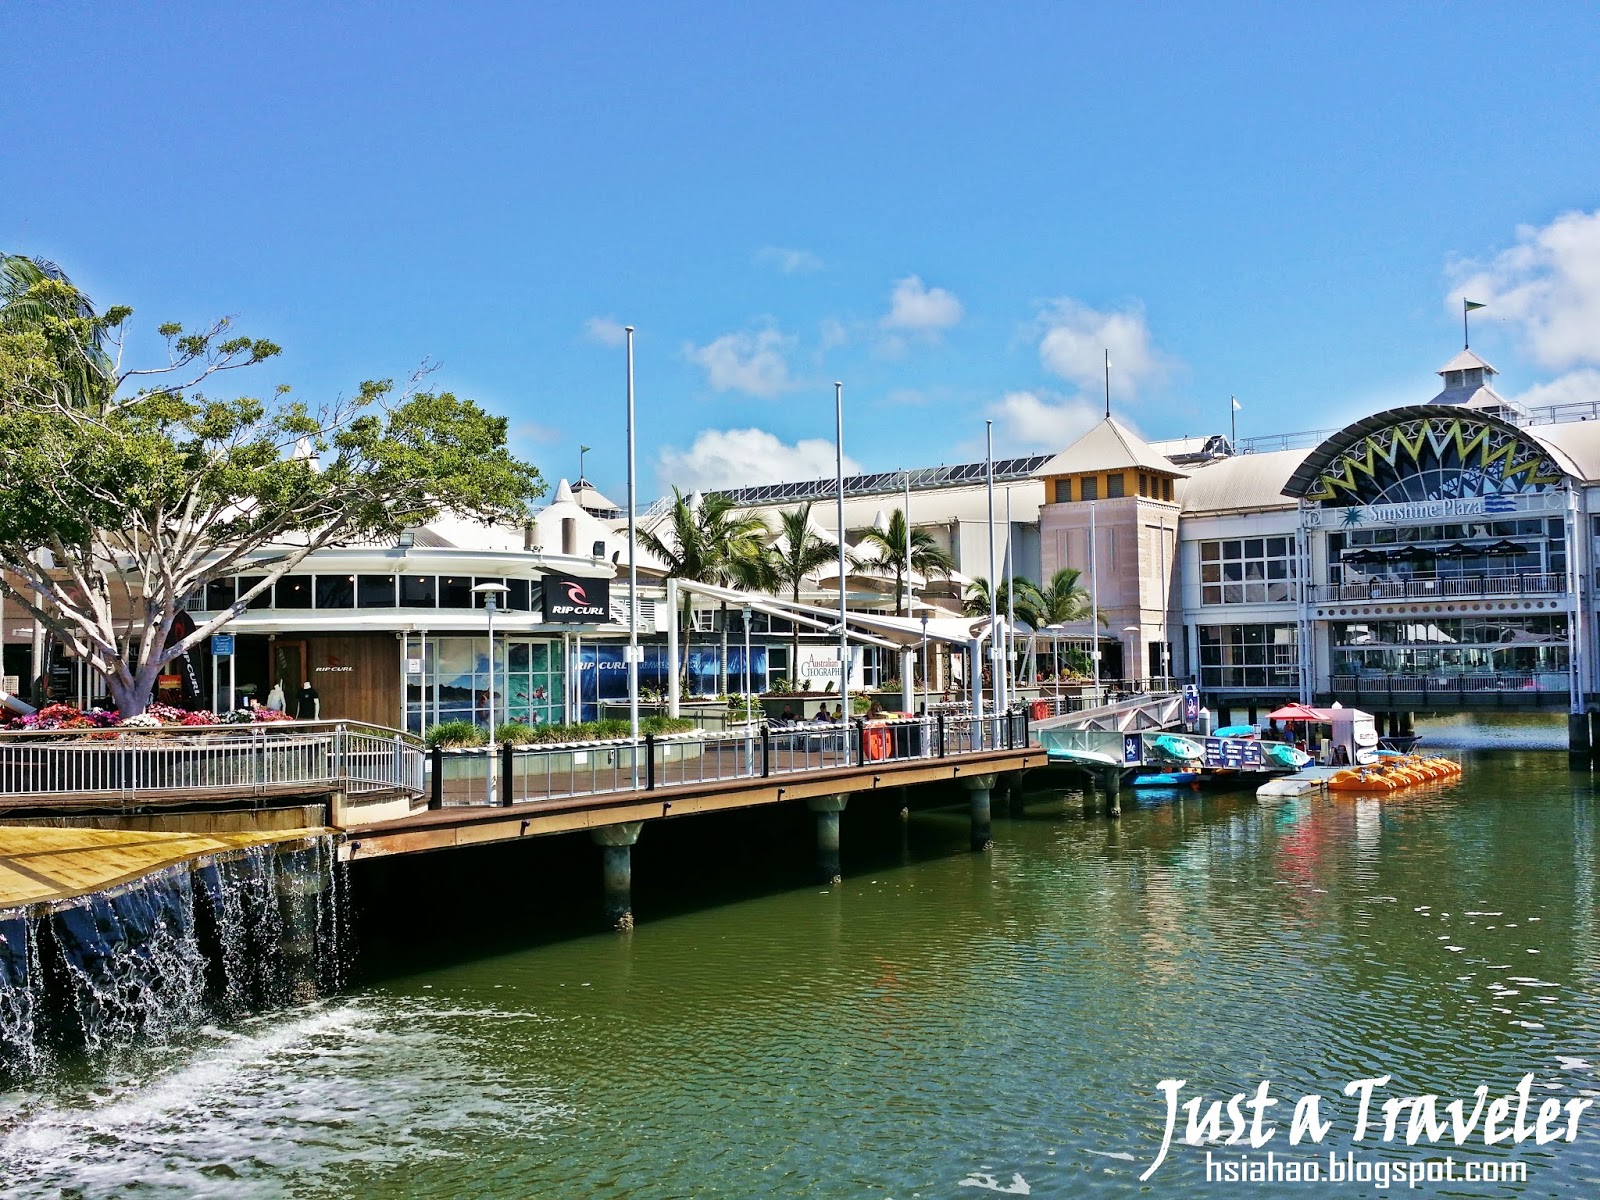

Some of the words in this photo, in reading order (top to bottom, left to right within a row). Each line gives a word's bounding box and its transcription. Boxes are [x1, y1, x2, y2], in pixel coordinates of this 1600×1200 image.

[1369, 501, 1438, 521] Sunshine
[1442, 499, 1483, 517] Plaza
[552, 605, 574, 614] RIP
[574, 606, 605, 615] CURL
[599, 661, 627, 670] CURL
[808, 653, 839, 668] Australian
[801, 661, 843, 678] GEOGRAPHI
[186, 664, 200, 697] CURL
